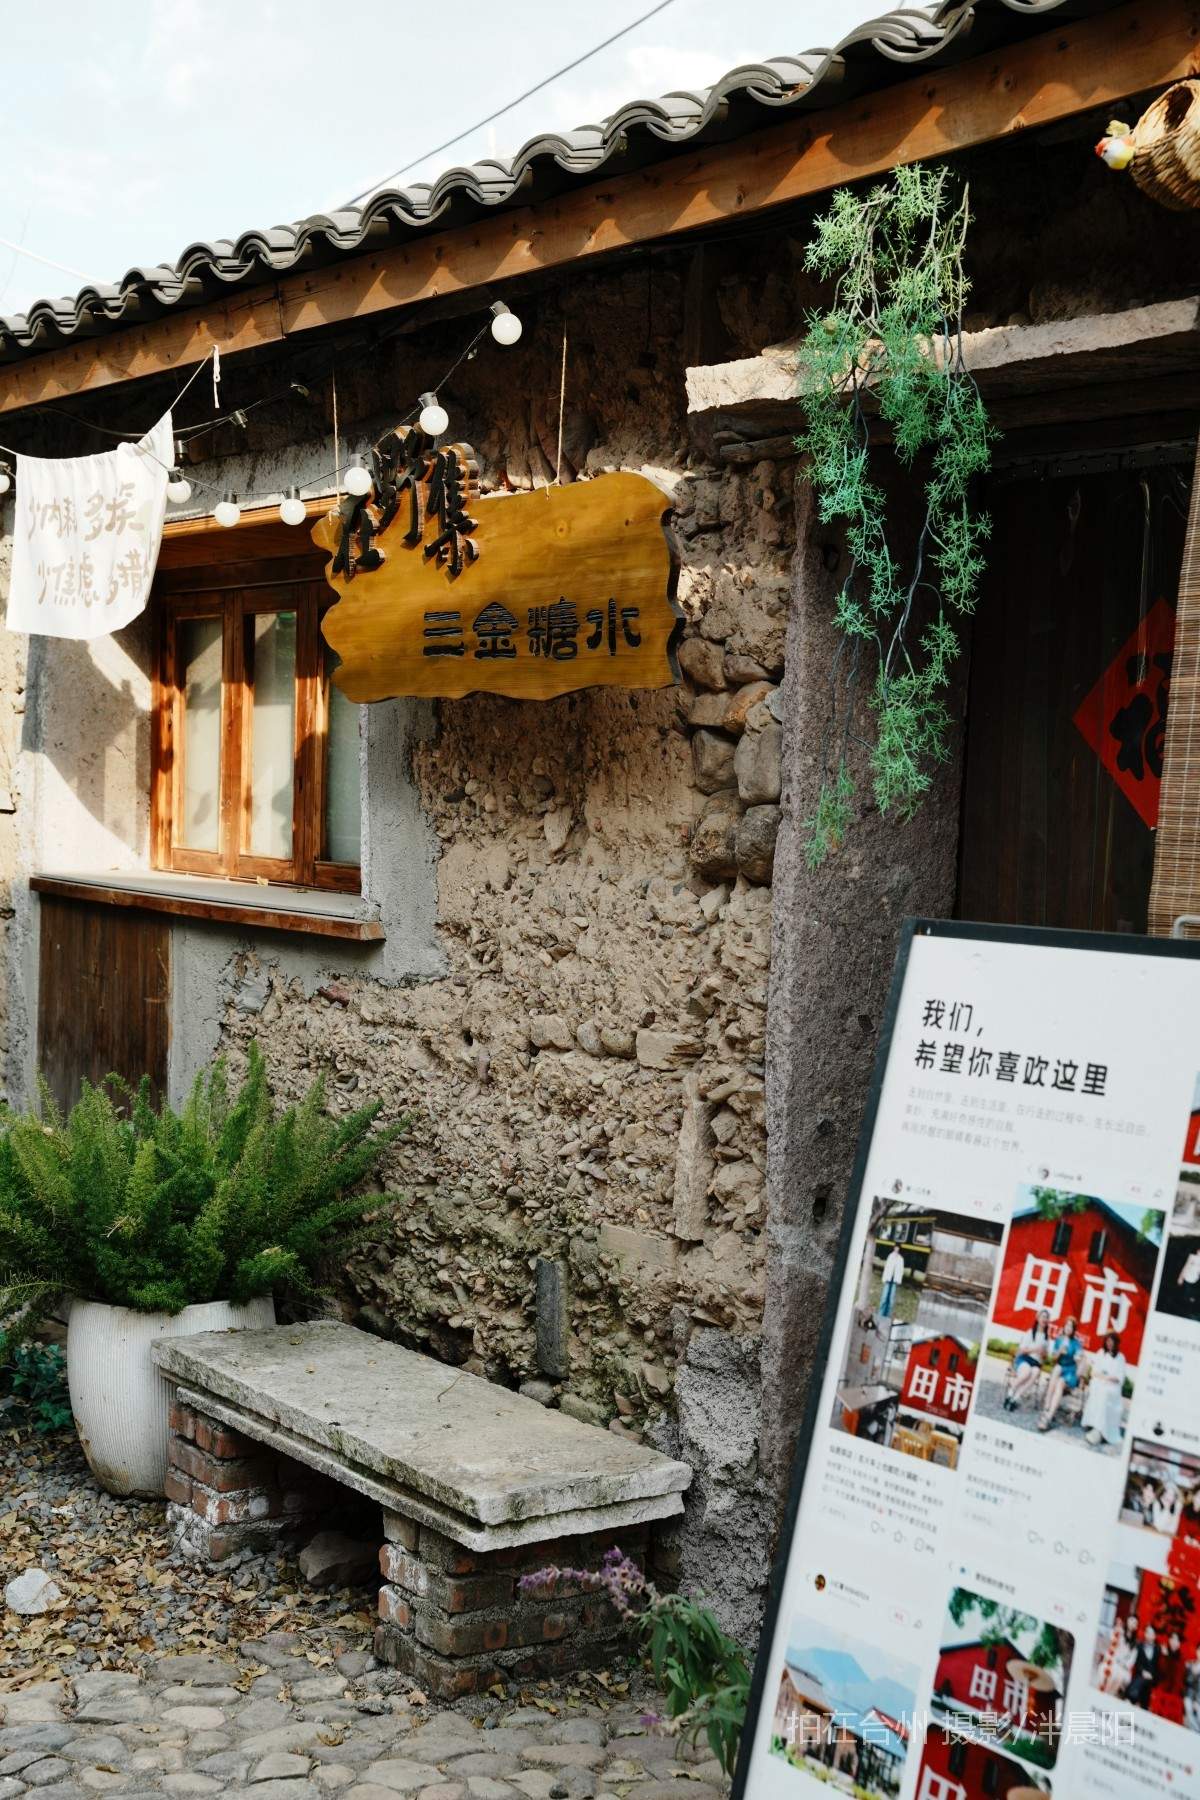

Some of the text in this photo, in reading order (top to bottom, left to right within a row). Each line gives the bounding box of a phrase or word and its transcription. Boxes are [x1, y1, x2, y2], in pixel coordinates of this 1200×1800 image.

[423, 596, 642, 661] 三金糖水
[914, 1039, 1109, 1097] 希望你喜欢这里
[1014, 1253, 1138, 1337] 田市
[908, 1365, 973, 1412] 田市
